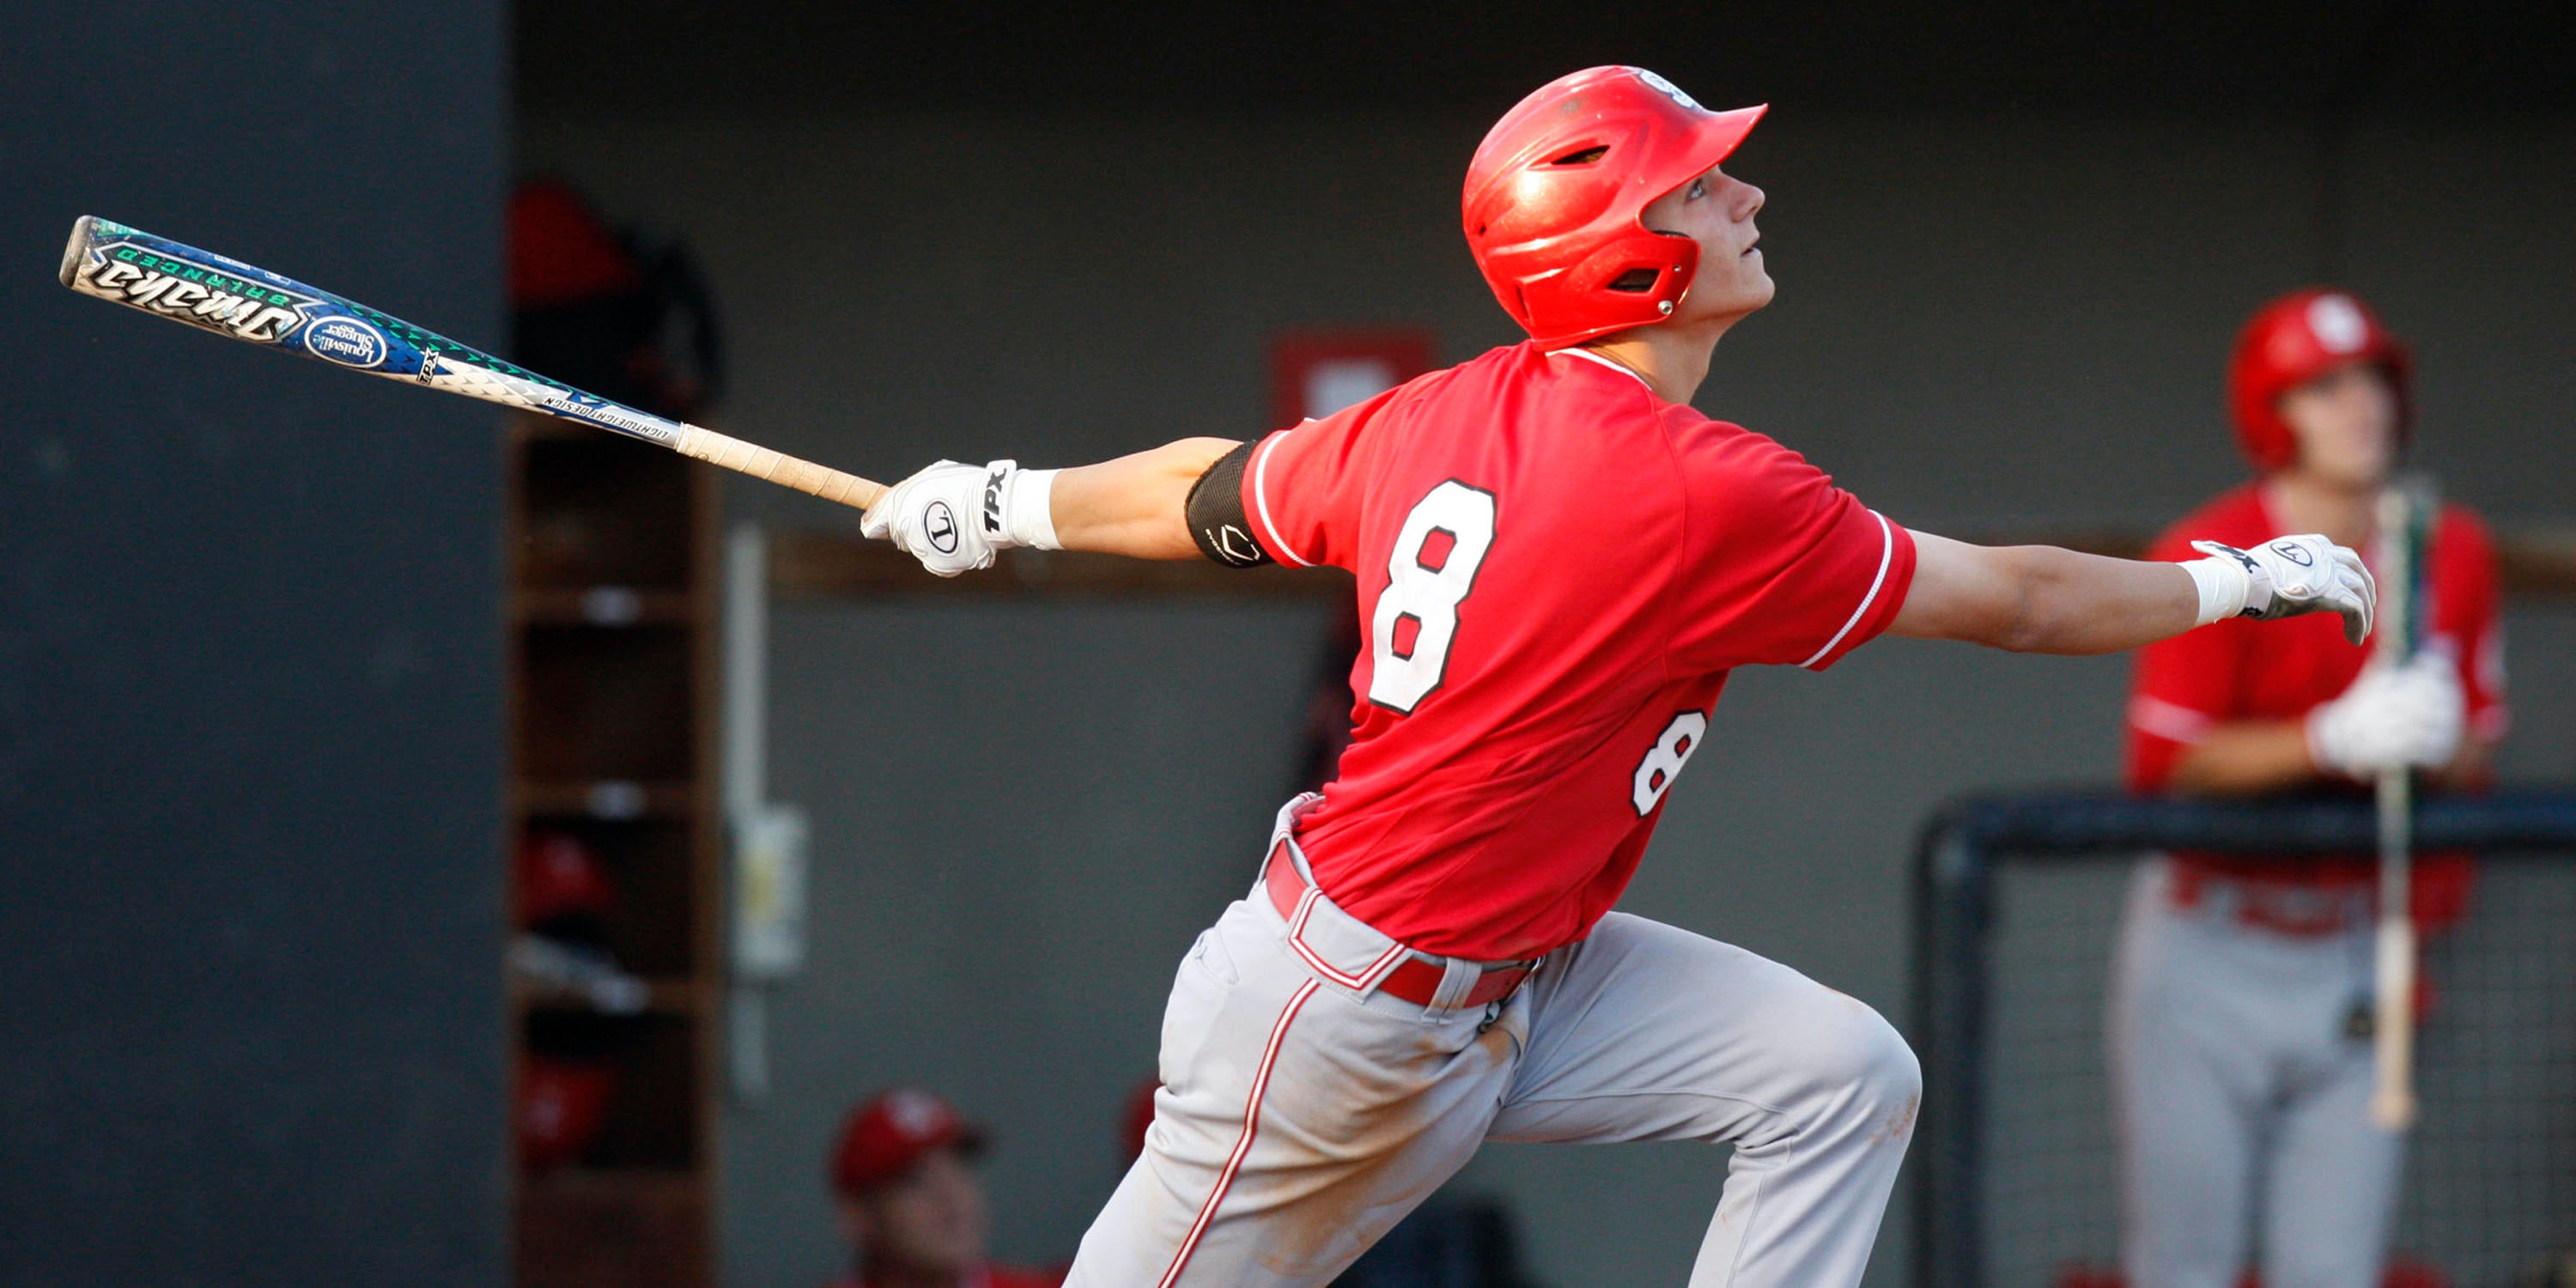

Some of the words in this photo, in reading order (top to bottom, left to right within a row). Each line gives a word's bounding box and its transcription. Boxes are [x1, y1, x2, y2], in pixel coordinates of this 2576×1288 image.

[117, 247, 290, 307] BALANCED
[312, 336, 374, 364] Louisville
[321, 323, 374, 351] Slugger
[419, 347, 439, 384] TPX
[544, 398, 590, 416] DESIGN
[984, 467, 1007, 533] TPX
[1368, 477, 1498, 716] 8
[1631, 708, 1708, 818] 8
